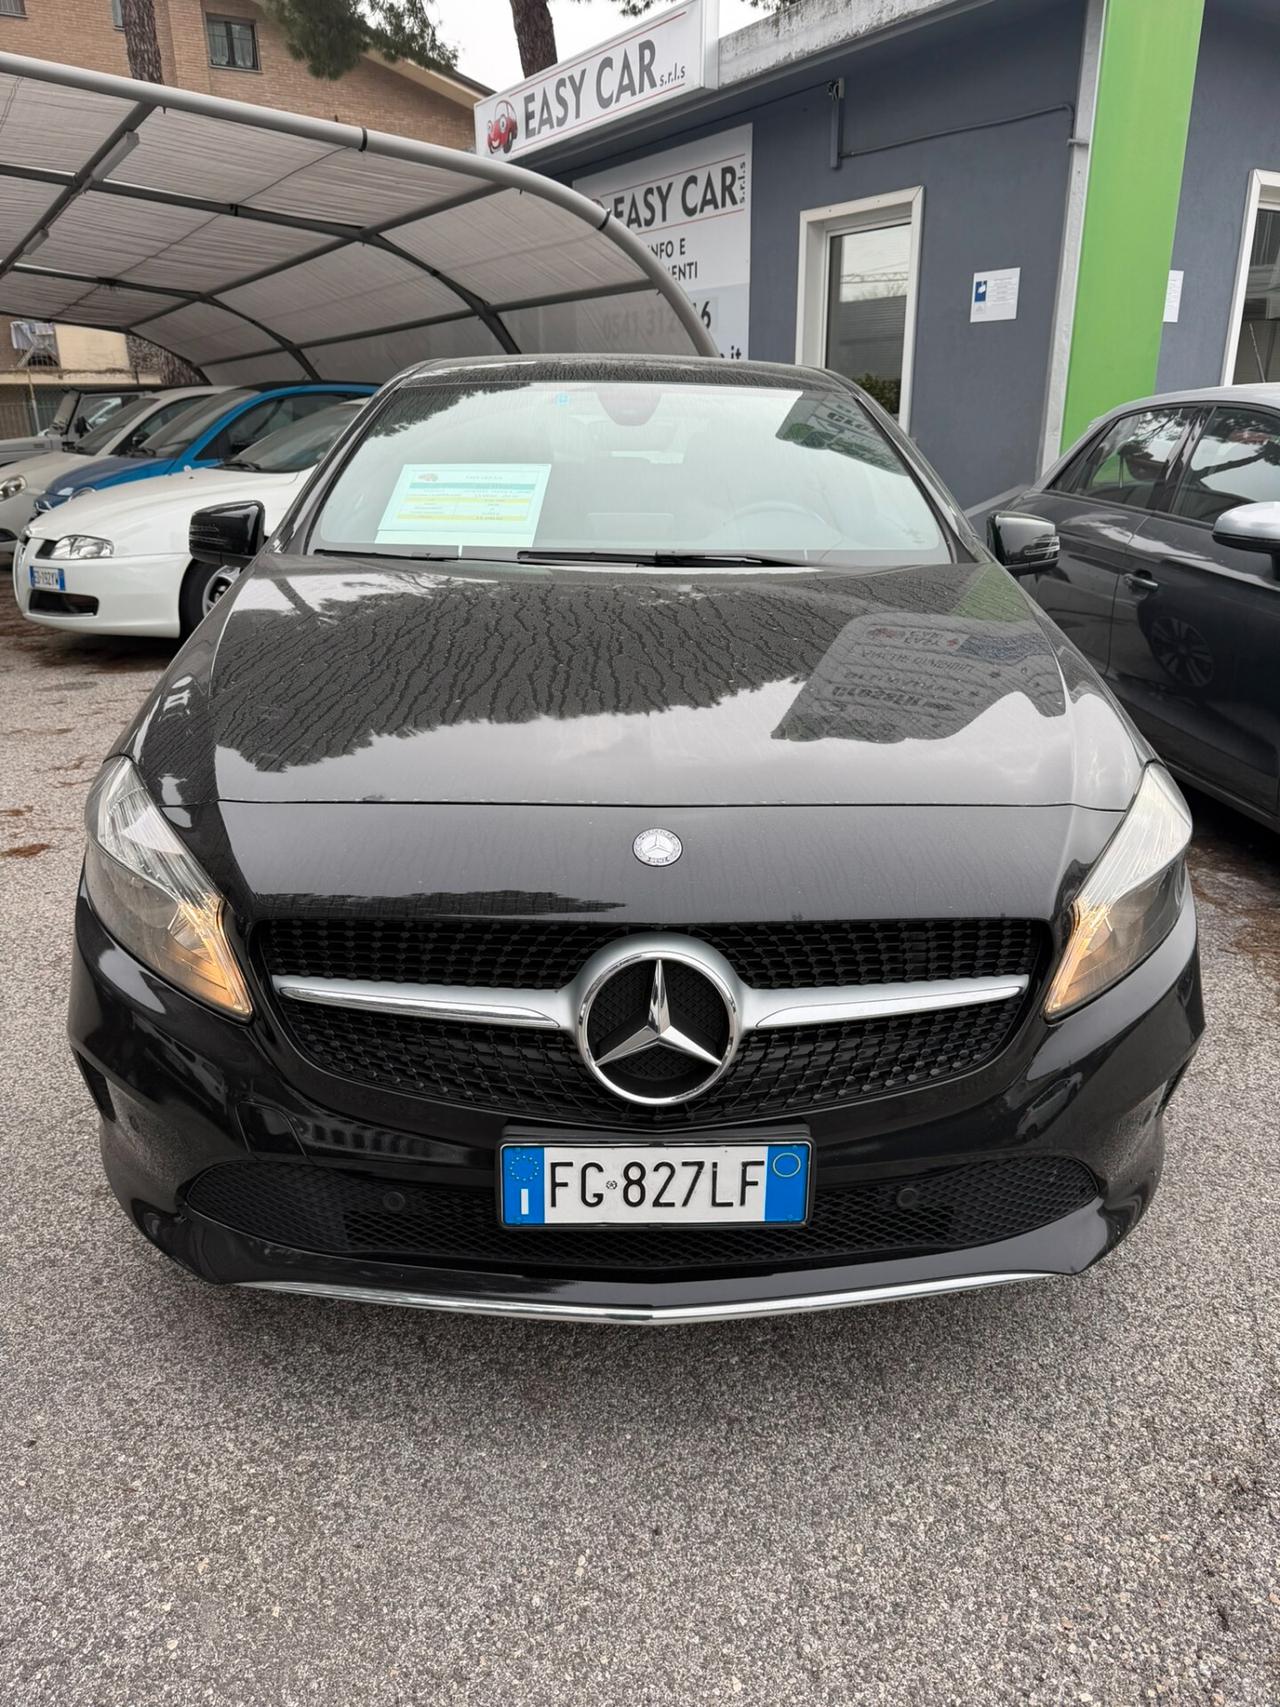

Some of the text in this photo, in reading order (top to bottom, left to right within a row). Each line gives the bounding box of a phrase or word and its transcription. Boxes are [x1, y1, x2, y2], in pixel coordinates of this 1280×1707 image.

[523, 39, 686, 139] EASY CAR s.r.l.s
[681, 166, 738, 217] CAR
[647, 238, 686, 260] NFO E
[550, 1160, 765, 1208] FG 827LF
